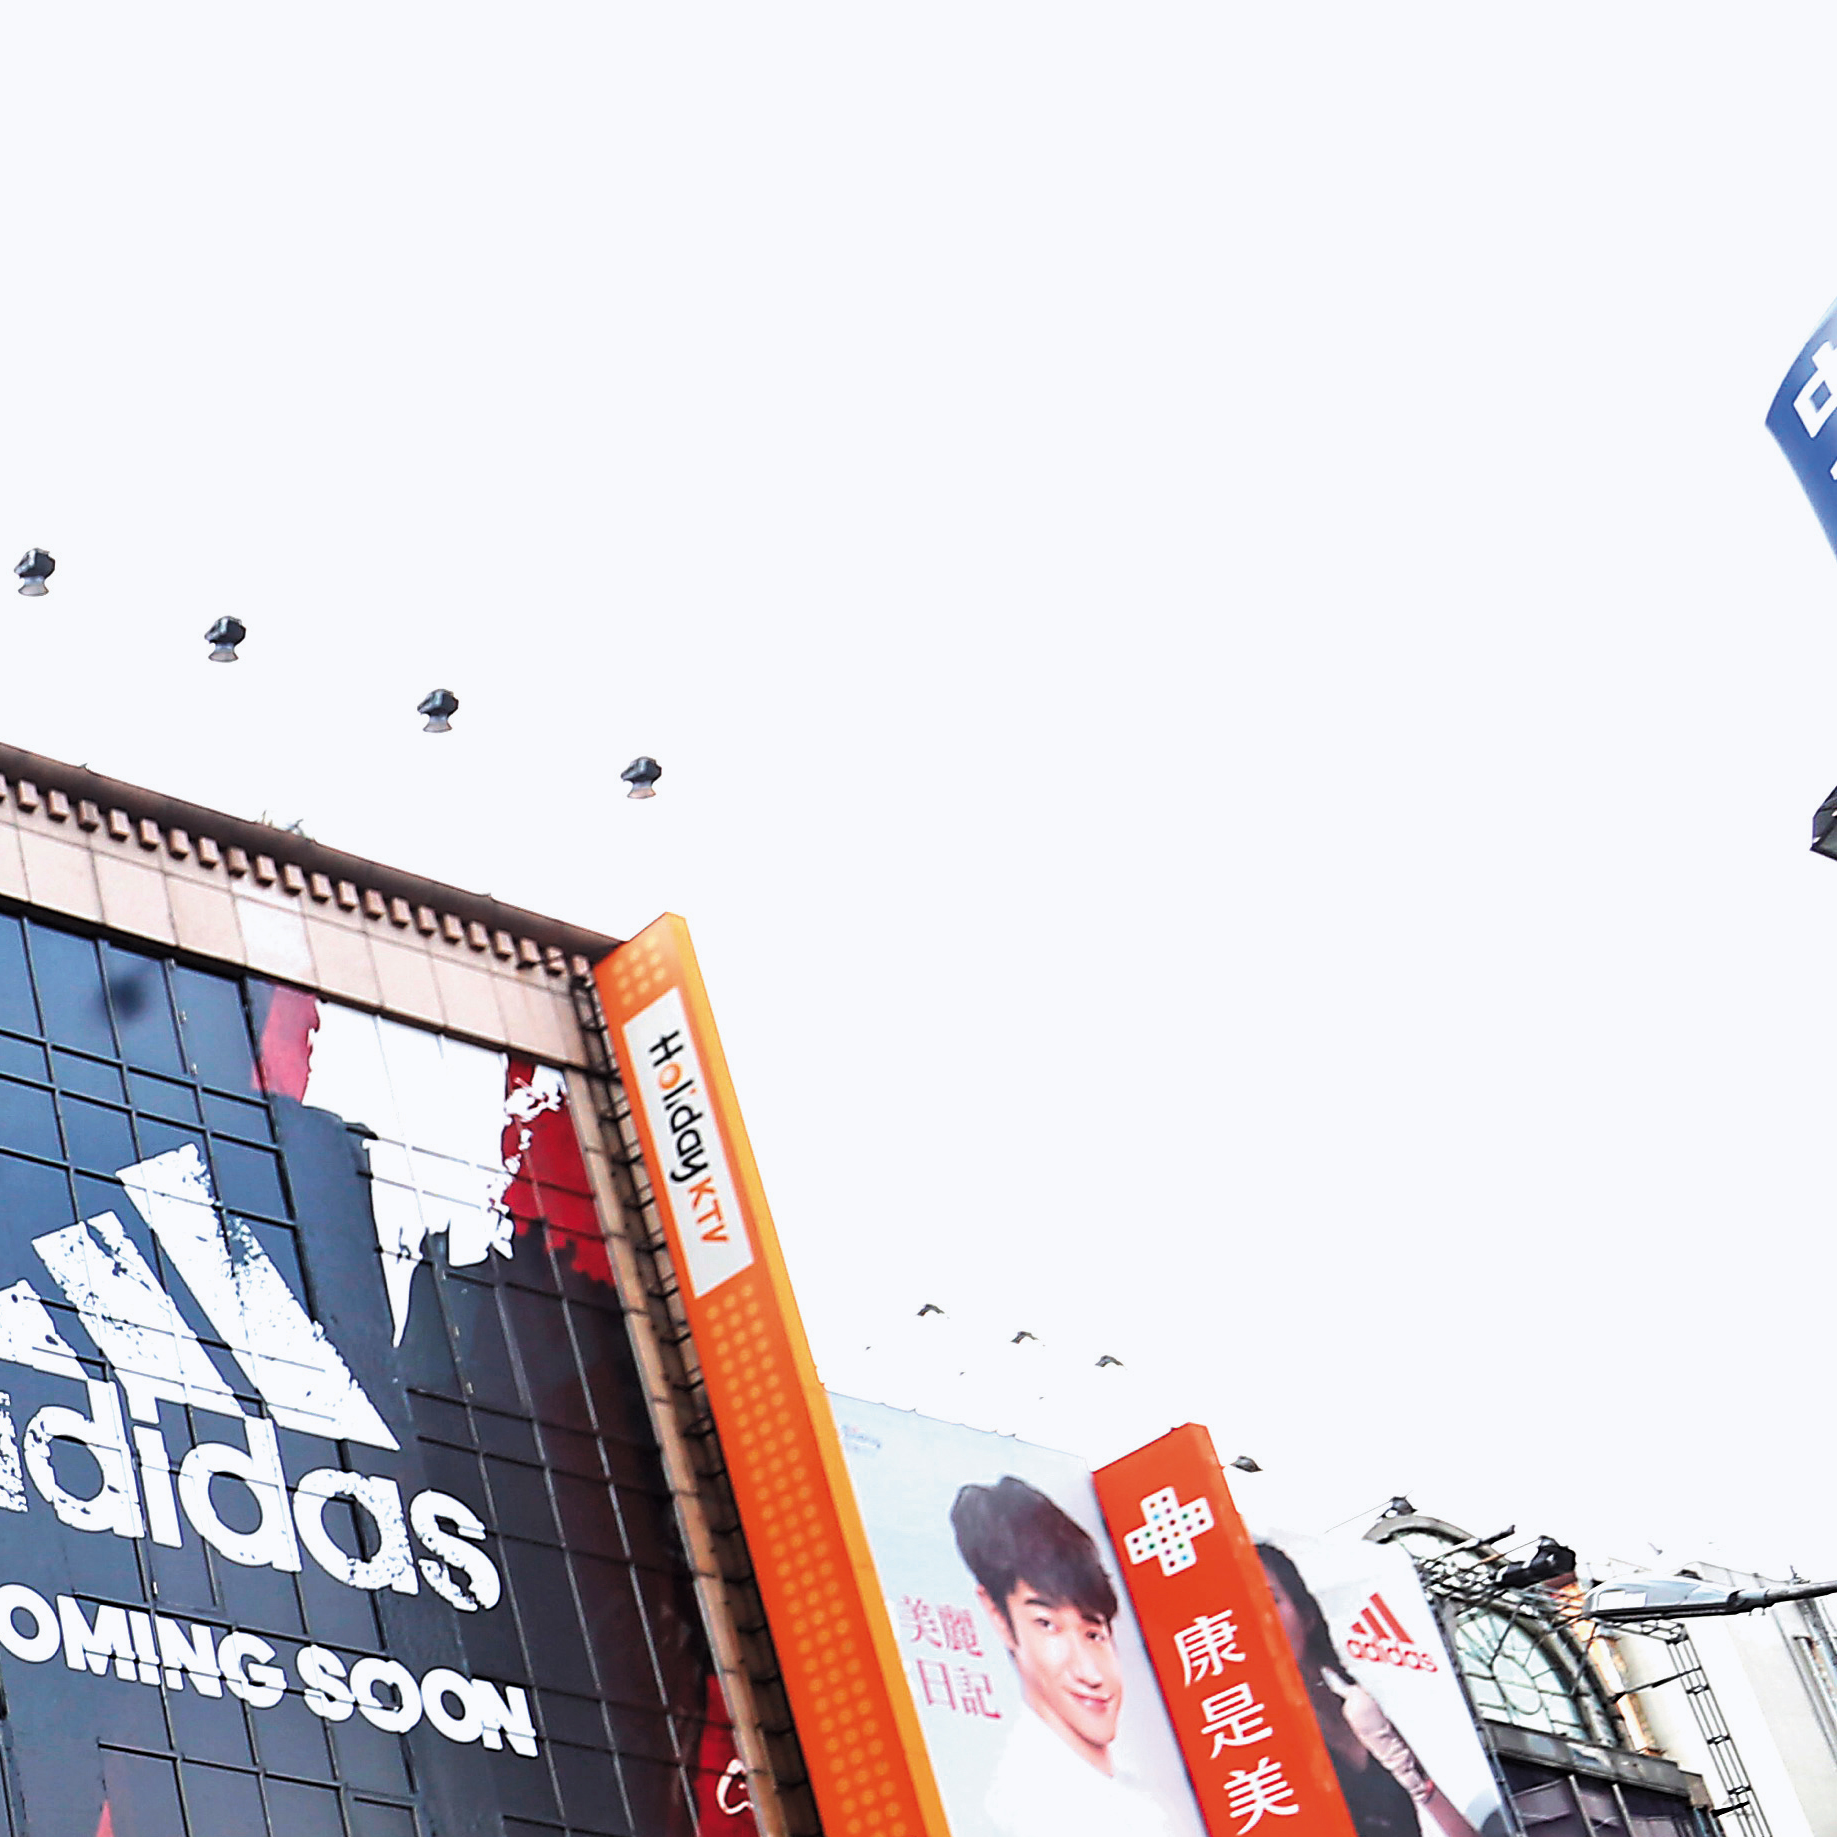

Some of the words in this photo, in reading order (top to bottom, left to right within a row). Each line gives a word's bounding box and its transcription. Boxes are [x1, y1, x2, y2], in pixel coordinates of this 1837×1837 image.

[648, 1030, 709, 1185] Holiday
[688, 1176, 730, 1245] KTV
[901, 1595, 984, 1660] 美麗
[1345, 1636, 1439, 1674] adidas
[296, 1643, 539, 1758] SOON
[921, 1657, 1003, 1722] 日記
[1171, 1606, 1300, 1836] 康是美
